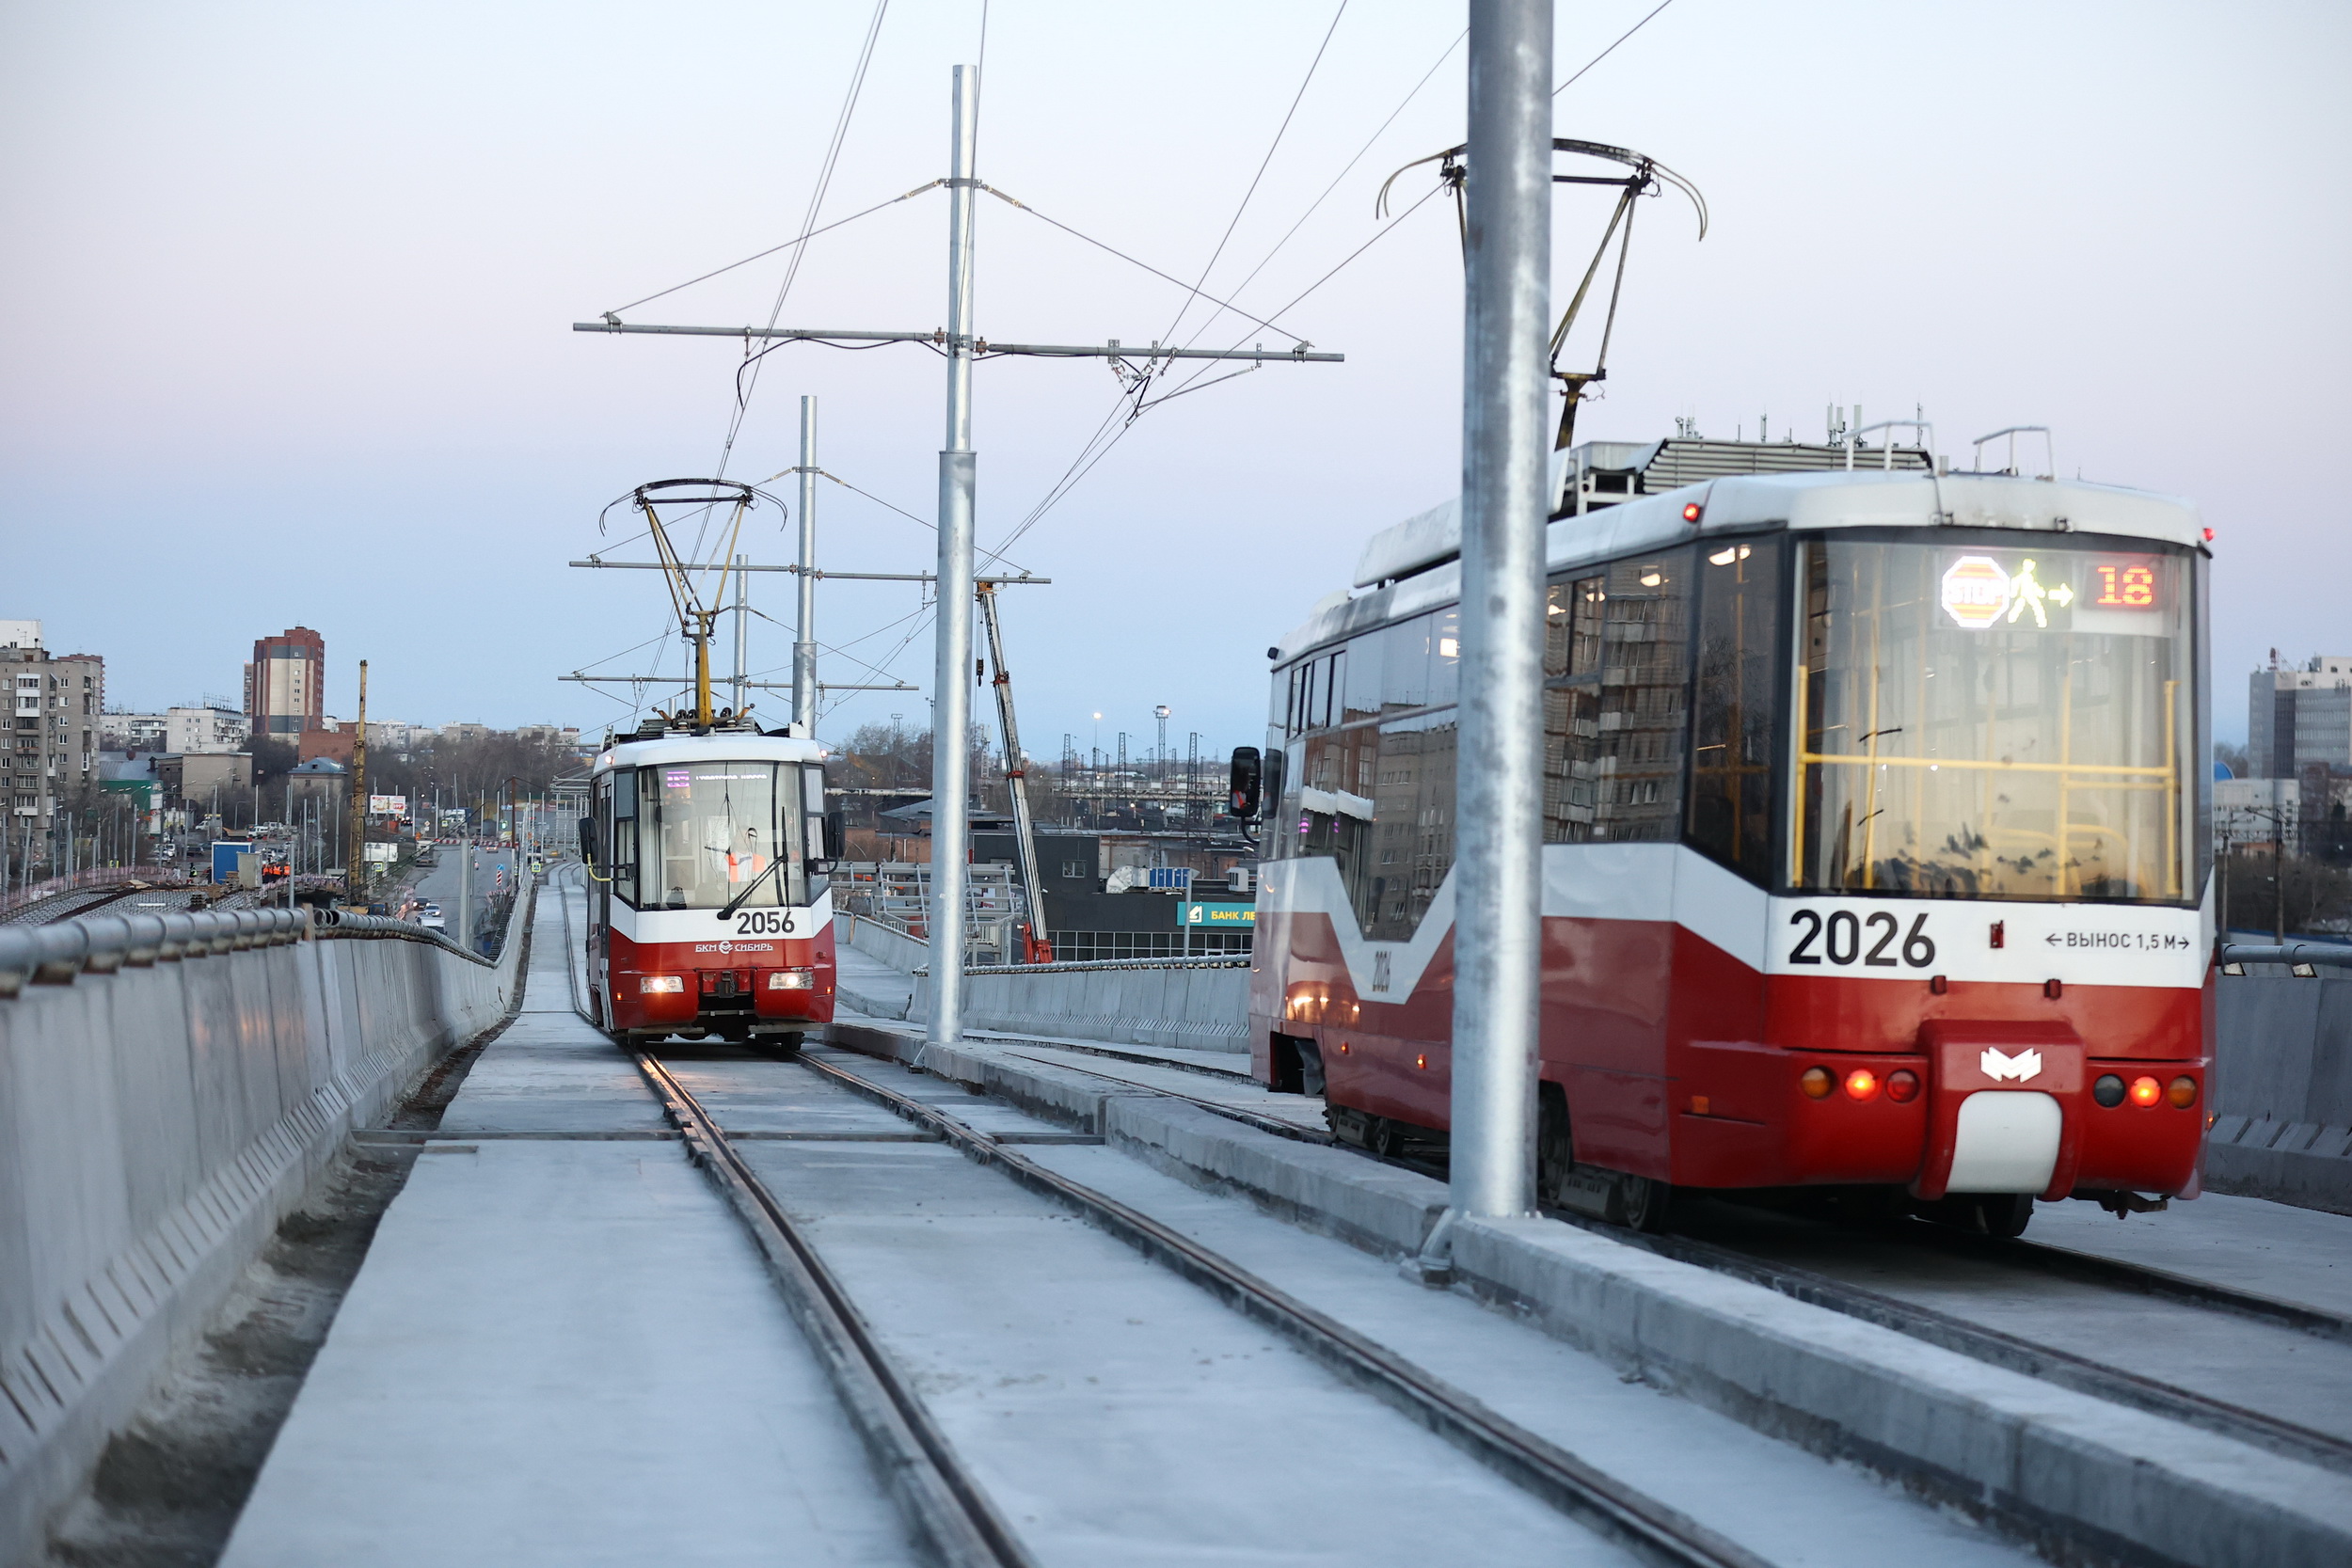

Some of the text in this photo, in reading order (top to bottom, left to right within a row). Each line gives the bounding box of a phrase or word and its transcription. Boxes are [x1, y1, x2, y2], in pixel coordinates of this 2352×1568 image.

[2097, 566, 2153, 605] 18
[737, 911, 795, 934] 2056
[1211, 911, 1239, 920] БАНК
[695, 943, 773, 953] БКМ СИБИРЬ
[1788, 909, 1935, 968] 2026
[2067, 932, 2176, 951] ВЫНОС 1,5 М
